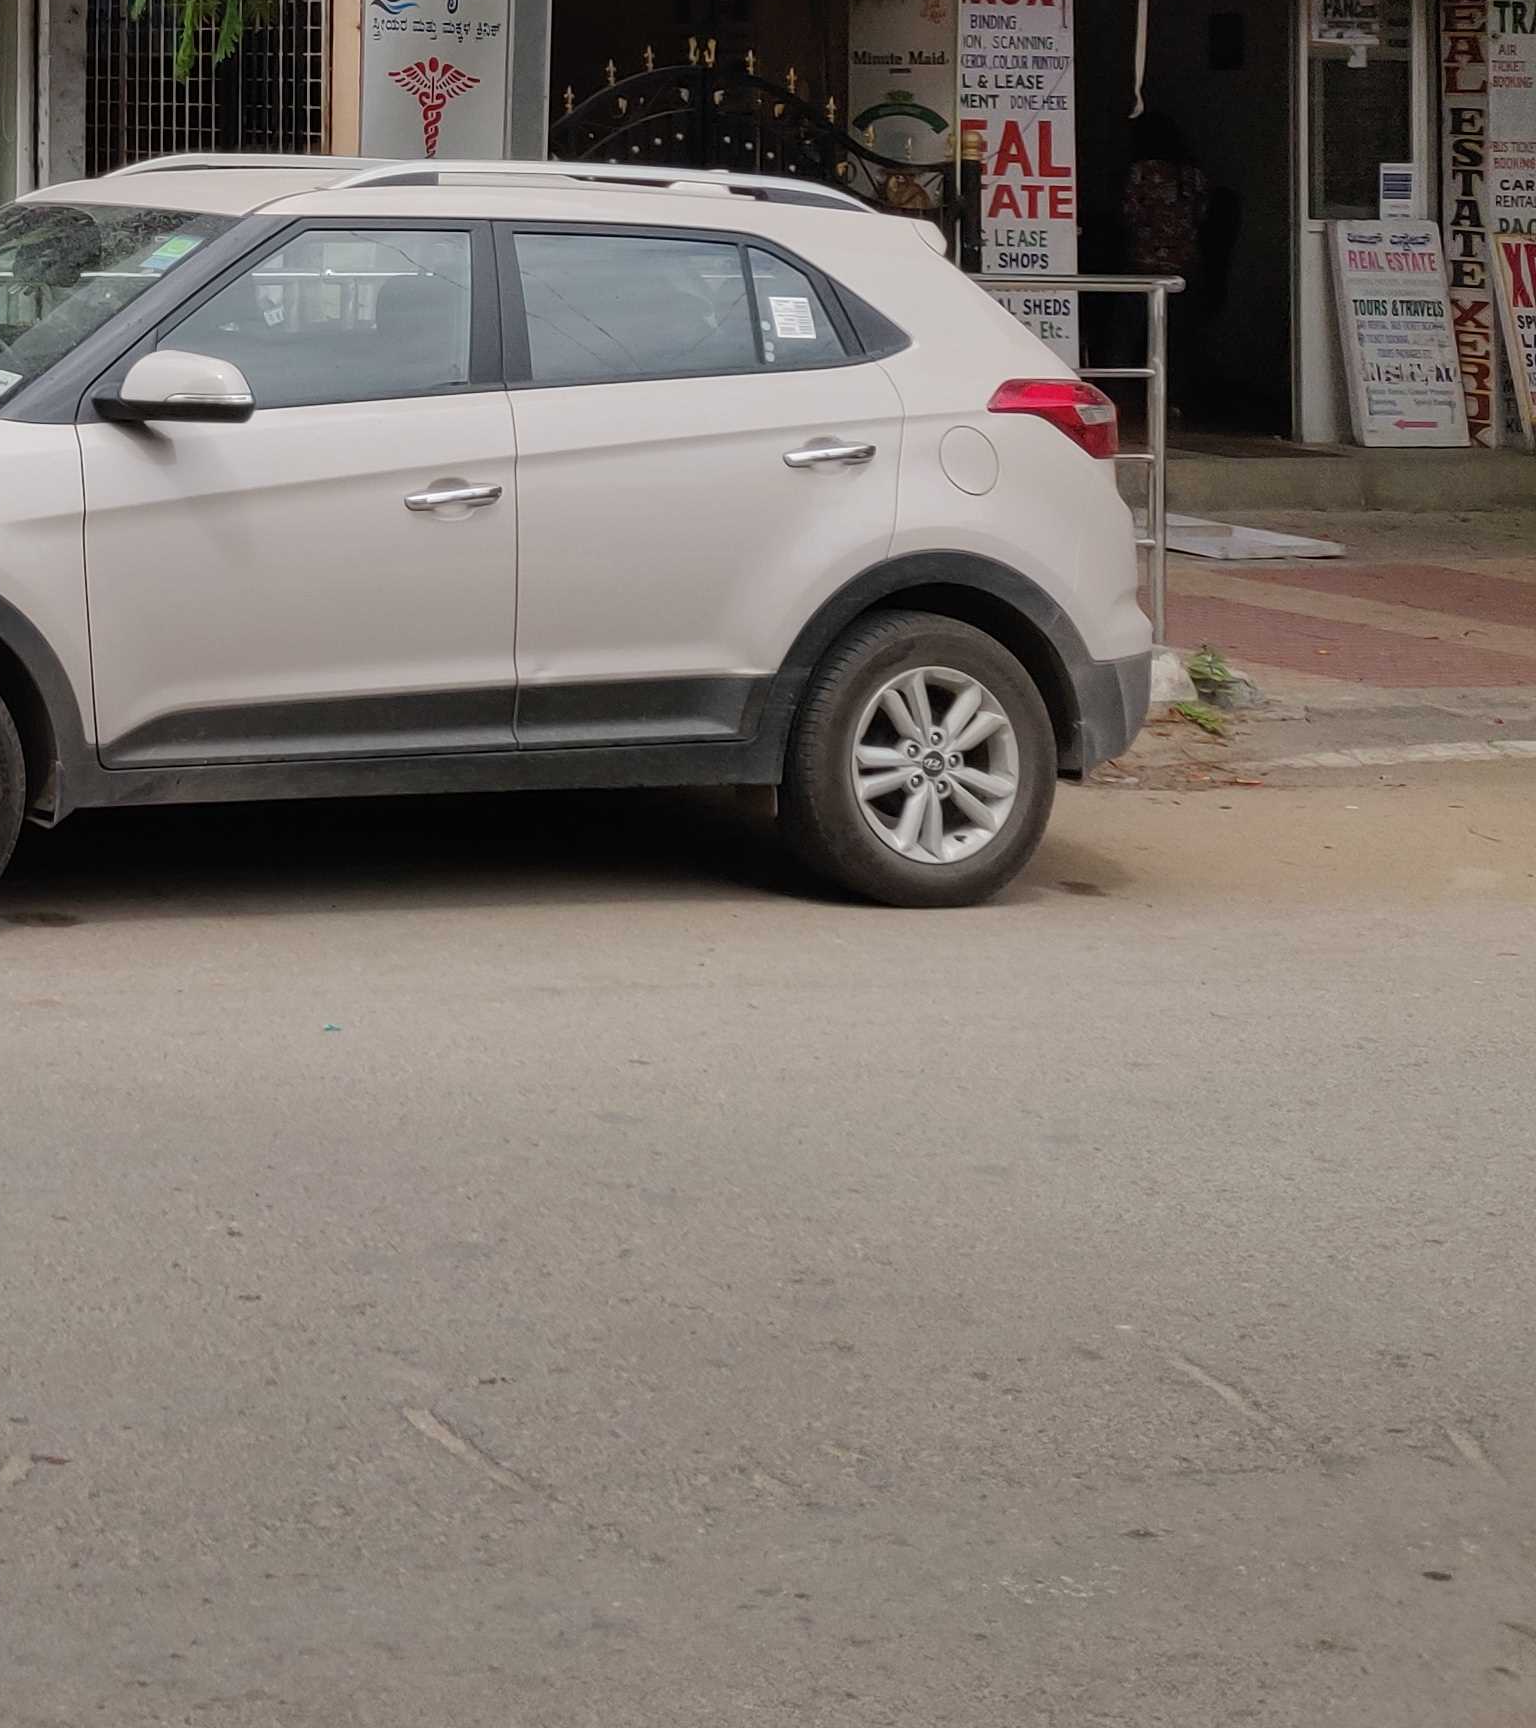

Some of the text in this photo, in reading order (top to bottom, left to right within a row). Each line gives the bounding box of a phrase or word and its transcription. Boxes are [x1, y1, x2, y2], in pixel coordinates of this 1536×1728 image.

[970, 14, 1017, 29] BINDING
[1498, 44, 1518, 56] AIR
[977, 74, 1044, 90] & LEASE
[1449, 108, 1486, 289] ESTATE
[995, 229, 1048, 247] LEASE
[998, 252, 1049, 269] SHOPS
[1347, 250, 1438, 272] REAL ESTATE
[1023, 298, 1071, 316] SHEDS
[1352, 299, 1388, 316] TOURS
[1040, 321, 1070, 340] Etc.
